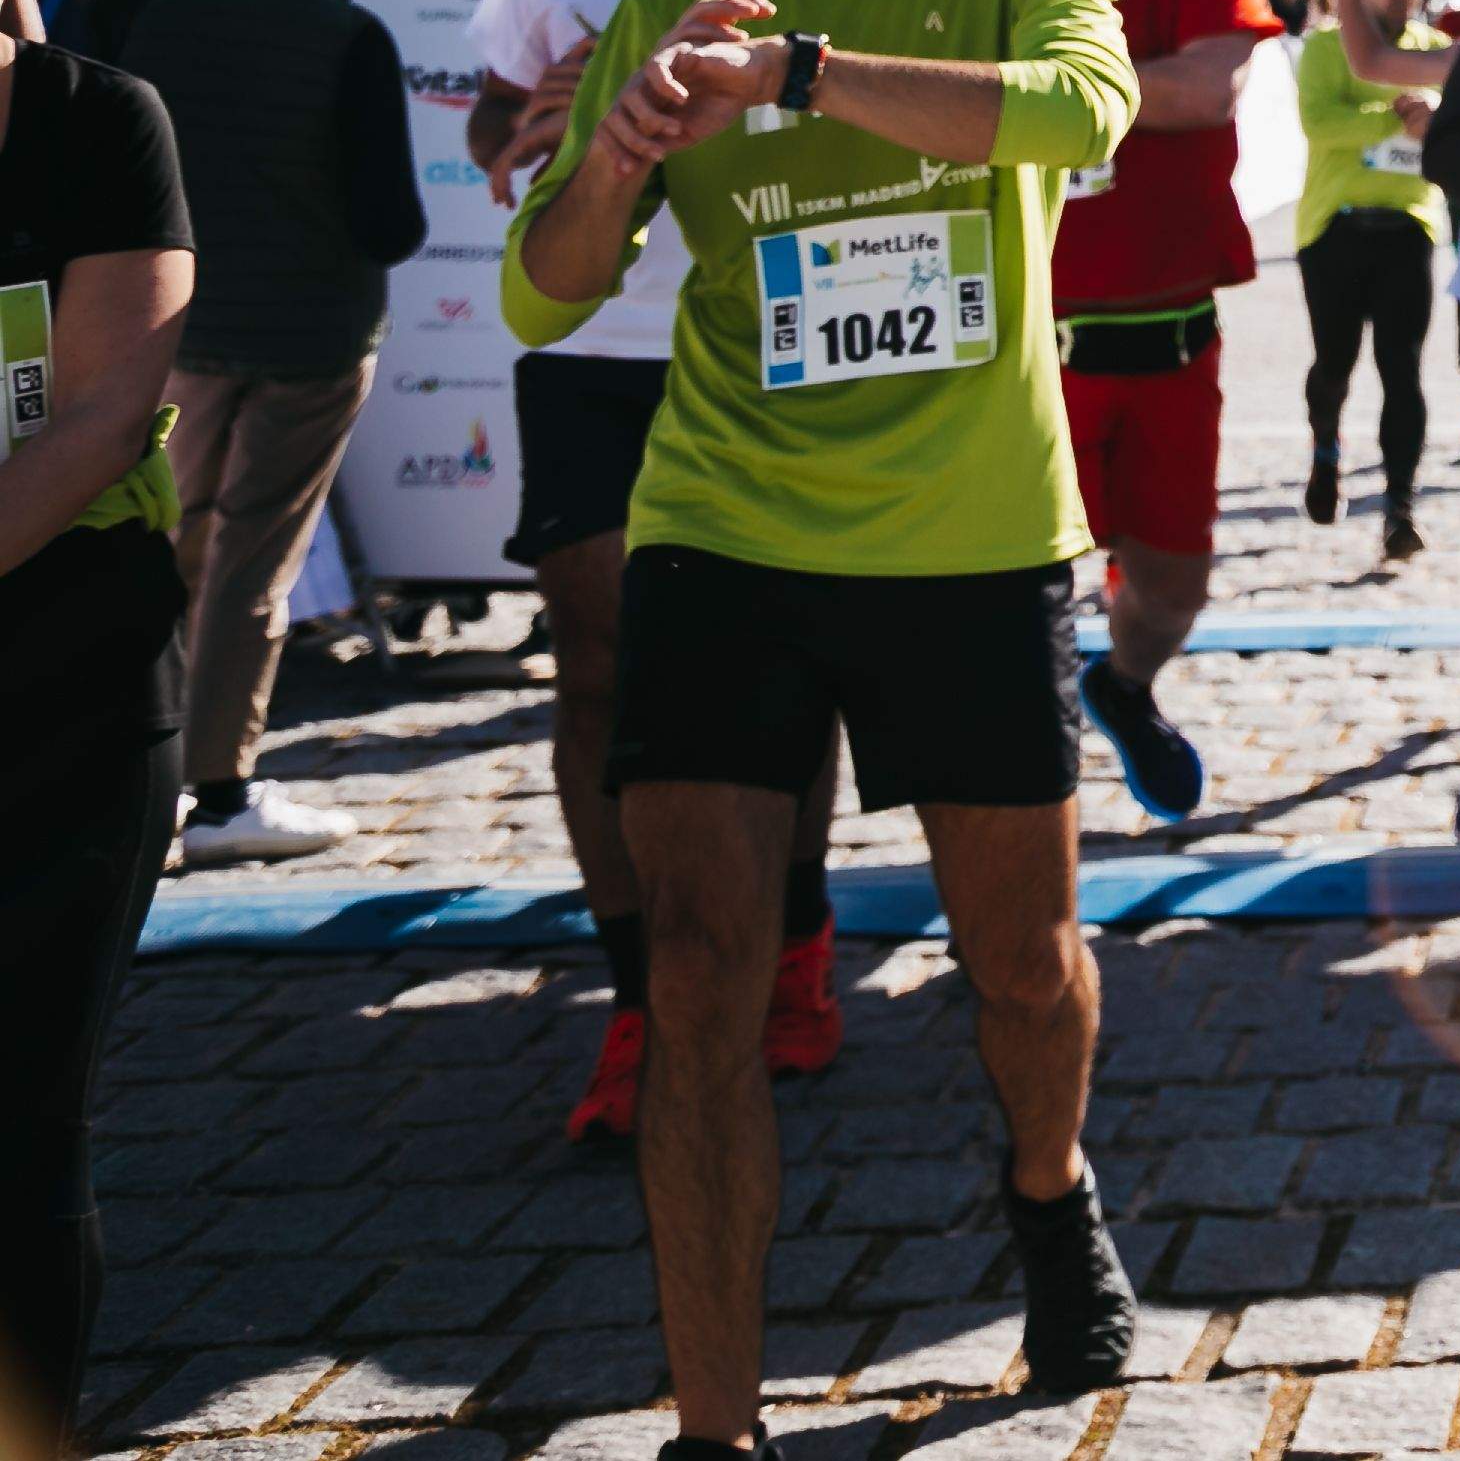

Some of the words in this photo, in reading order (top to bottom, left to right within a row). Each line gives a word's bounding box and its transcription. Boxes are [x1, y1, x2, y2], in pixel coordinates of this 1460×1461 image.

[731, 182, 793, 226] VIII
[848, 232, 942, 259] MetLife
[817, 304, 937, 366] 1042
